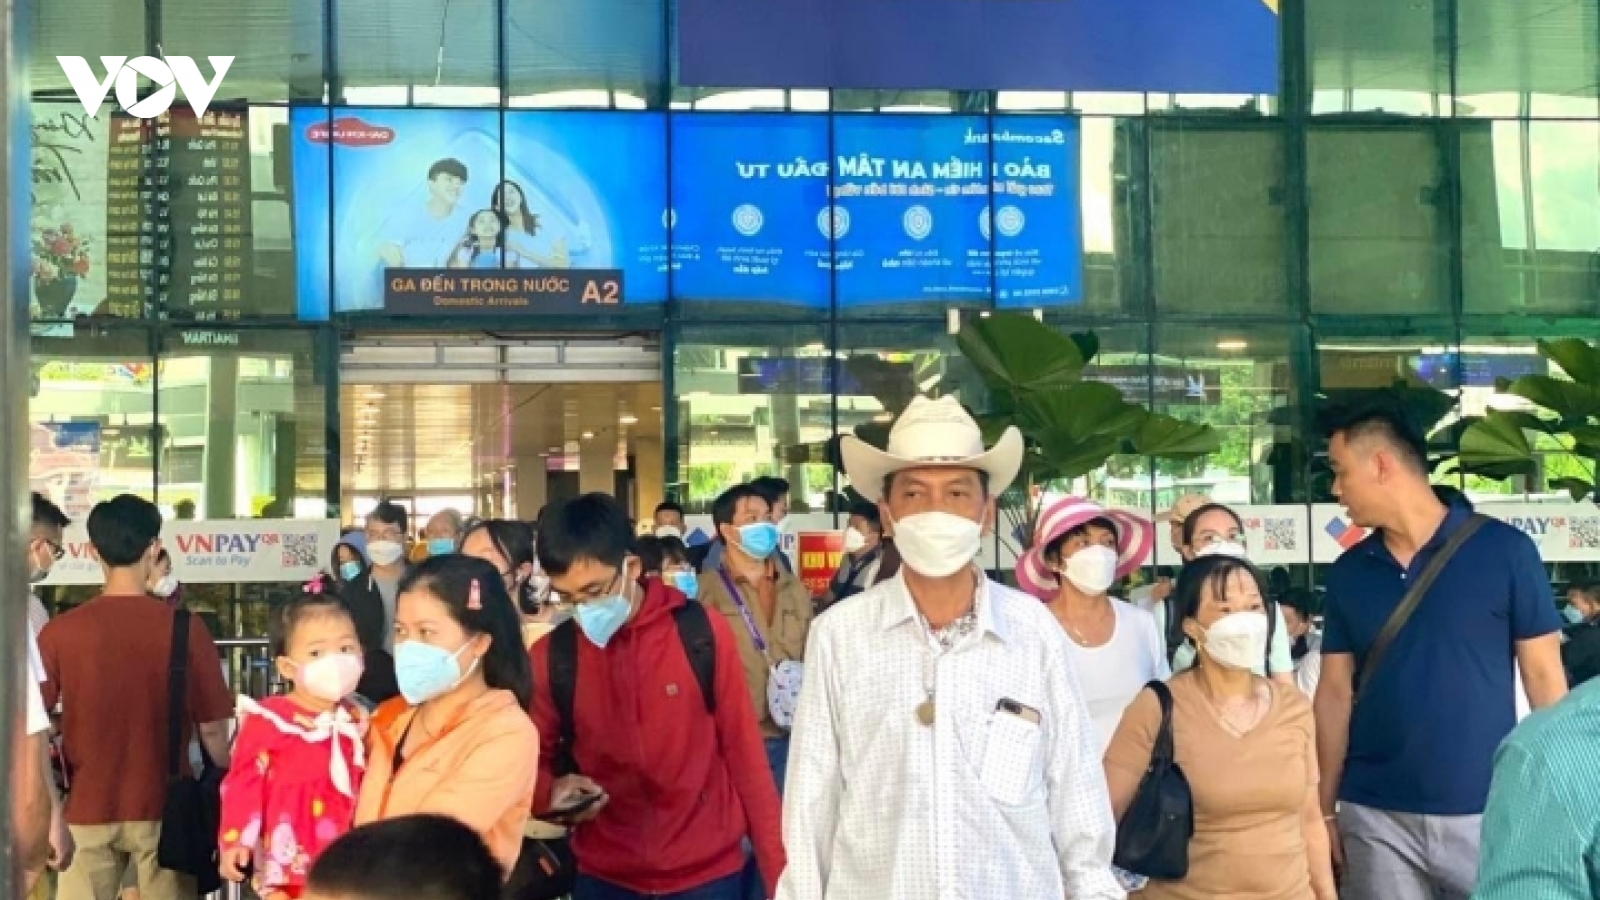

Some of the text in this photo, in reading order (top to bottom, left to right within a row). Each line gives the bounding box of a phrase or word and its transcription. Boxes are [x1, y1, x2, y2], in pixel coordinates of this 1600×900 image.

[390, 277, 416, 292] GA
[420, 273, 454, 292] ĐẾN
[460, 277, 518, 292] TRONG
[581, 279, 619, 304] A2
[433, 295, 529, 306] Domestic Arrivals
[185, 554, 251, 568] Scan to Pay
